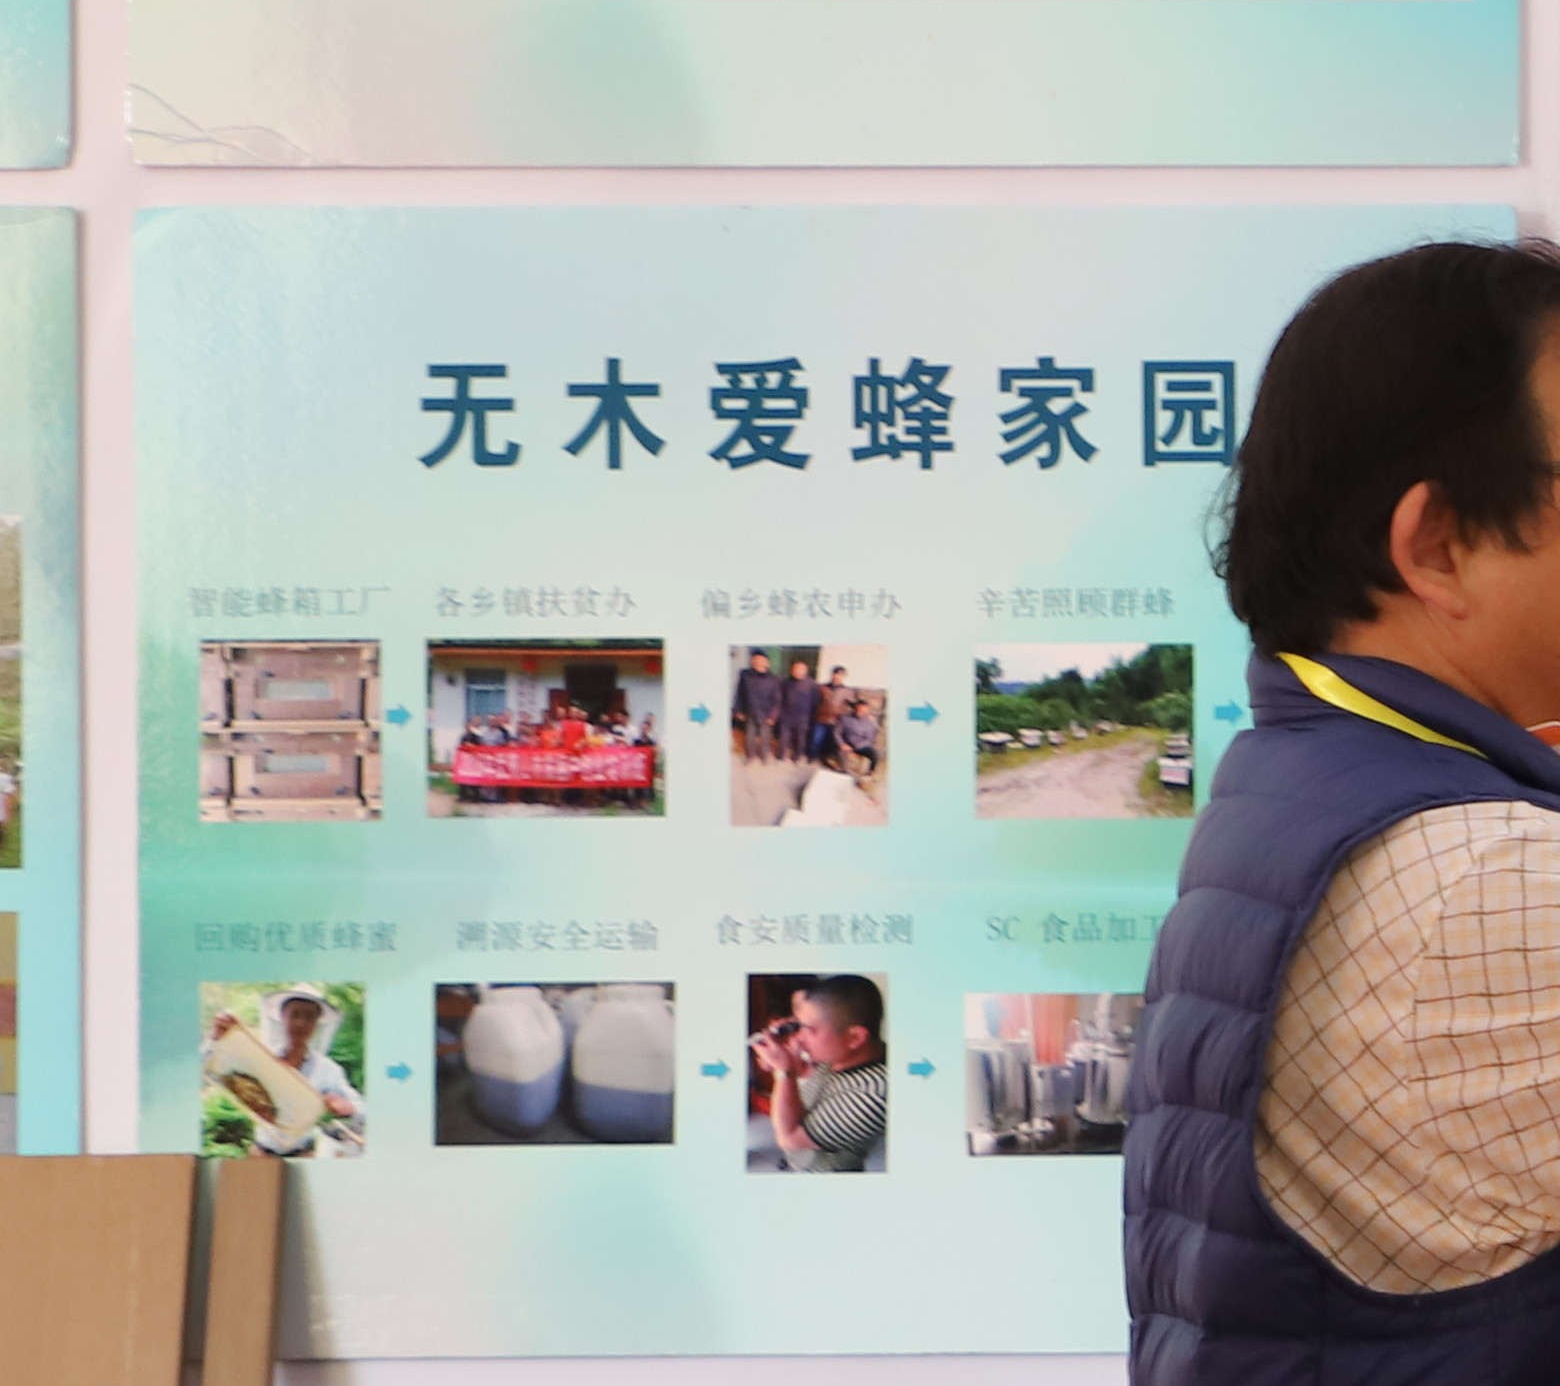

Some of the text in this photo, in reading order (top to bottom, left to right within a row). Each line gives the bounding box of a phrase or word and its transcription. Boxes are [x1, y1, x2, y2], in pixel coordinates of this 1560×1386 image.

[416, 356, 1238, 471] 无木爱蜂家园
[188, 584, 392, 619] 智能蜂箱工厂
[434, 585, 640, 619] 各乡镇扶贫办
[700, 586, 903, 621] 偏乡蜂农申办
[977, 586, 1176, 620] 辛苦照顾群蜂
[194, 919, 400, 953] 回购优质蜂蜜
[455, 919, 660, 952] 溯源安全运输
[716, 912, 915, 945] 食安质量检测
[984, 915, 1021, 942] SC
